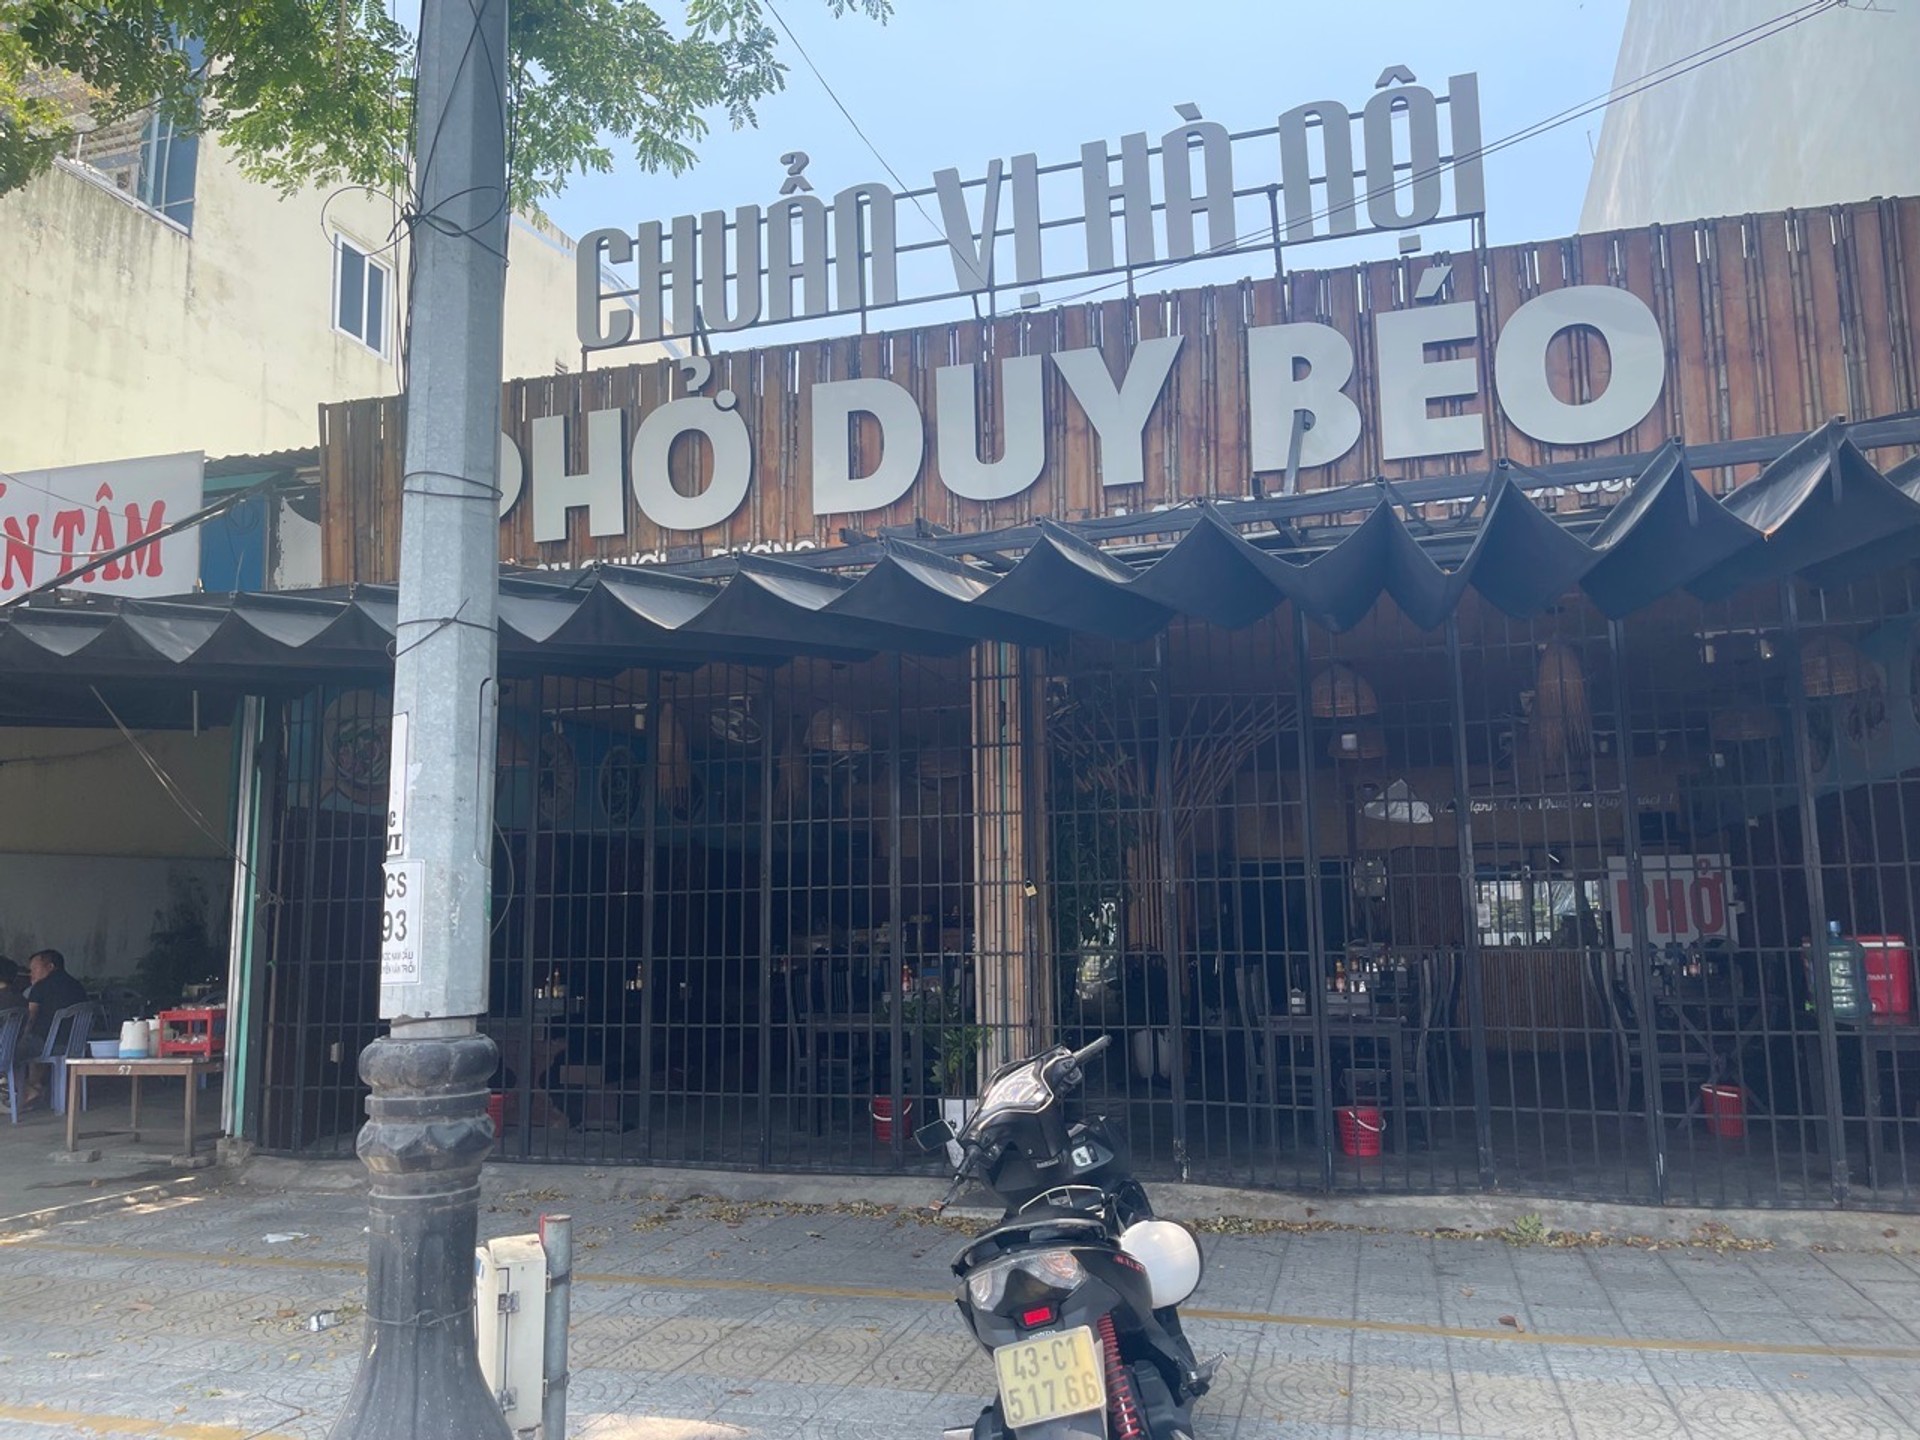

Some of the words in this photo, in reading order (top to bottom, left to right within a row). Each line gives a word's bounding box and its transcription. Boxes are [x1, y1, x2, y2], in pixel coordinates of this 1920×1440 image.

[576, 151, 897, 349] CHUẨN
[932, 153, 1042, 309] VỊ
[1081, 102, 1237, 271] HÀ
[1278, 64, 1486, 254] NỘI
[812, 335, 1185, 515] DUY
[1248, 266, 1665, 472] BÉO
[0, 482, 40, 591] N
[53, 482, 166, 585] TÂM
[384, 872, 407, 899] CS
[382, 909, 407, 943] 93
[1013, 1337, 1079, 1380] 43-C1
[1007, 1371, 1099, 1421] 517.66
